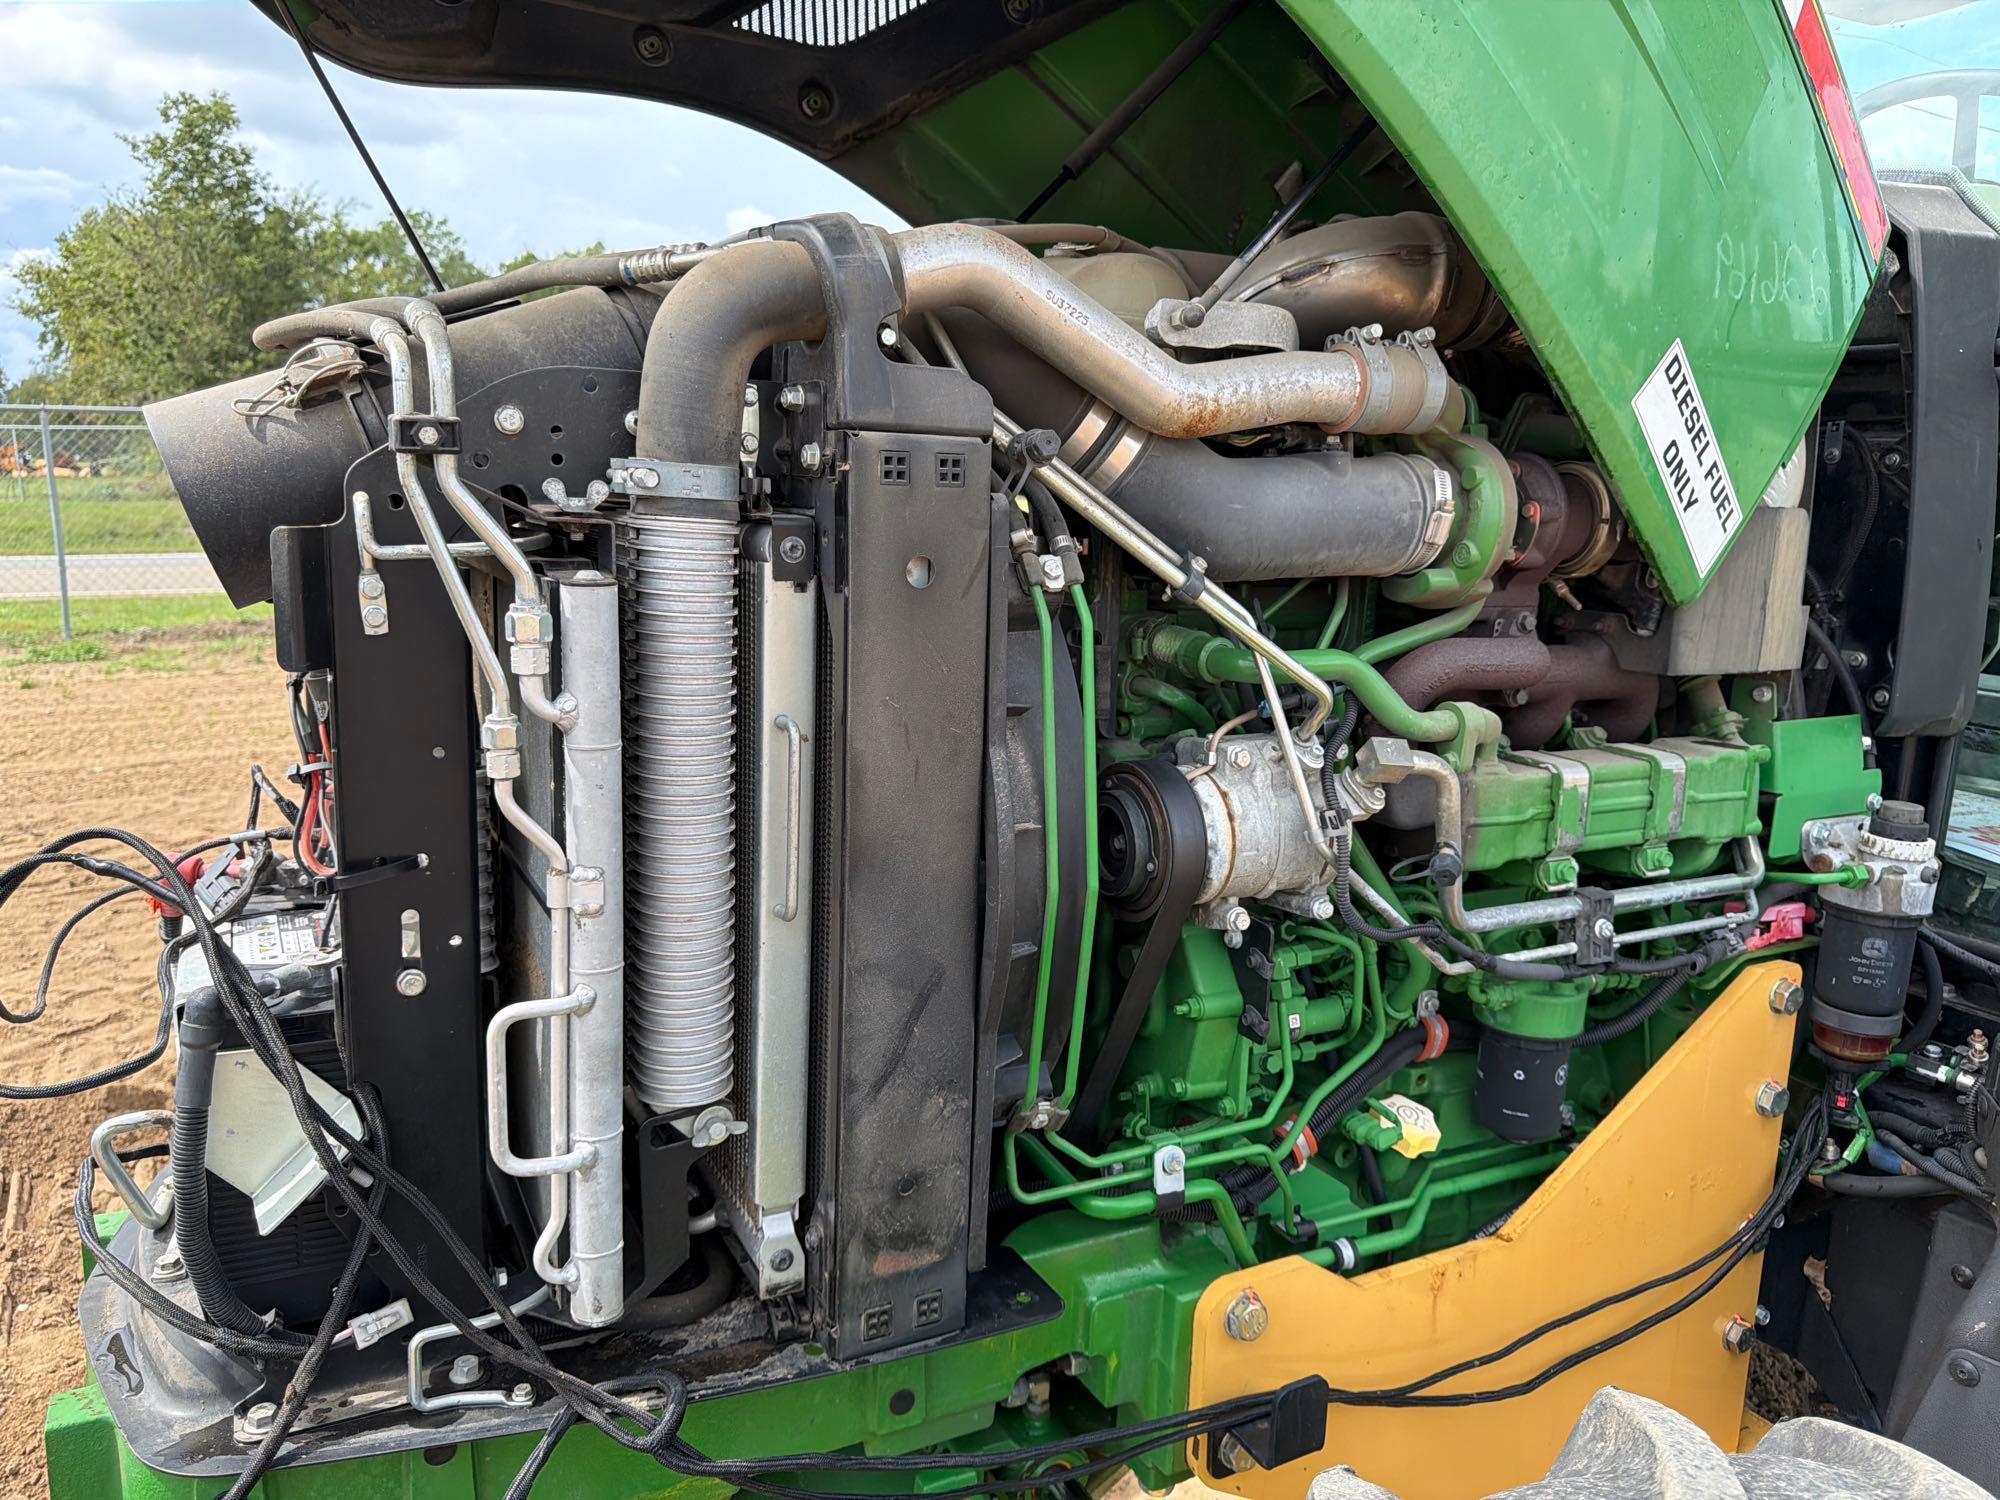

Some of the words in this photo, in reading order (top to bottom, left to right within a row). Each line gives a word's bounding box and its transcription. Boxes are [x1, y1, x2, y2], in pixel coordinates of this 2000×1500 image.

[1662, 439, 1700, 515] ONLY
[1664, 353, 1711, 467] DIESEL
[1704, 458, 1735, 535] FUEL
